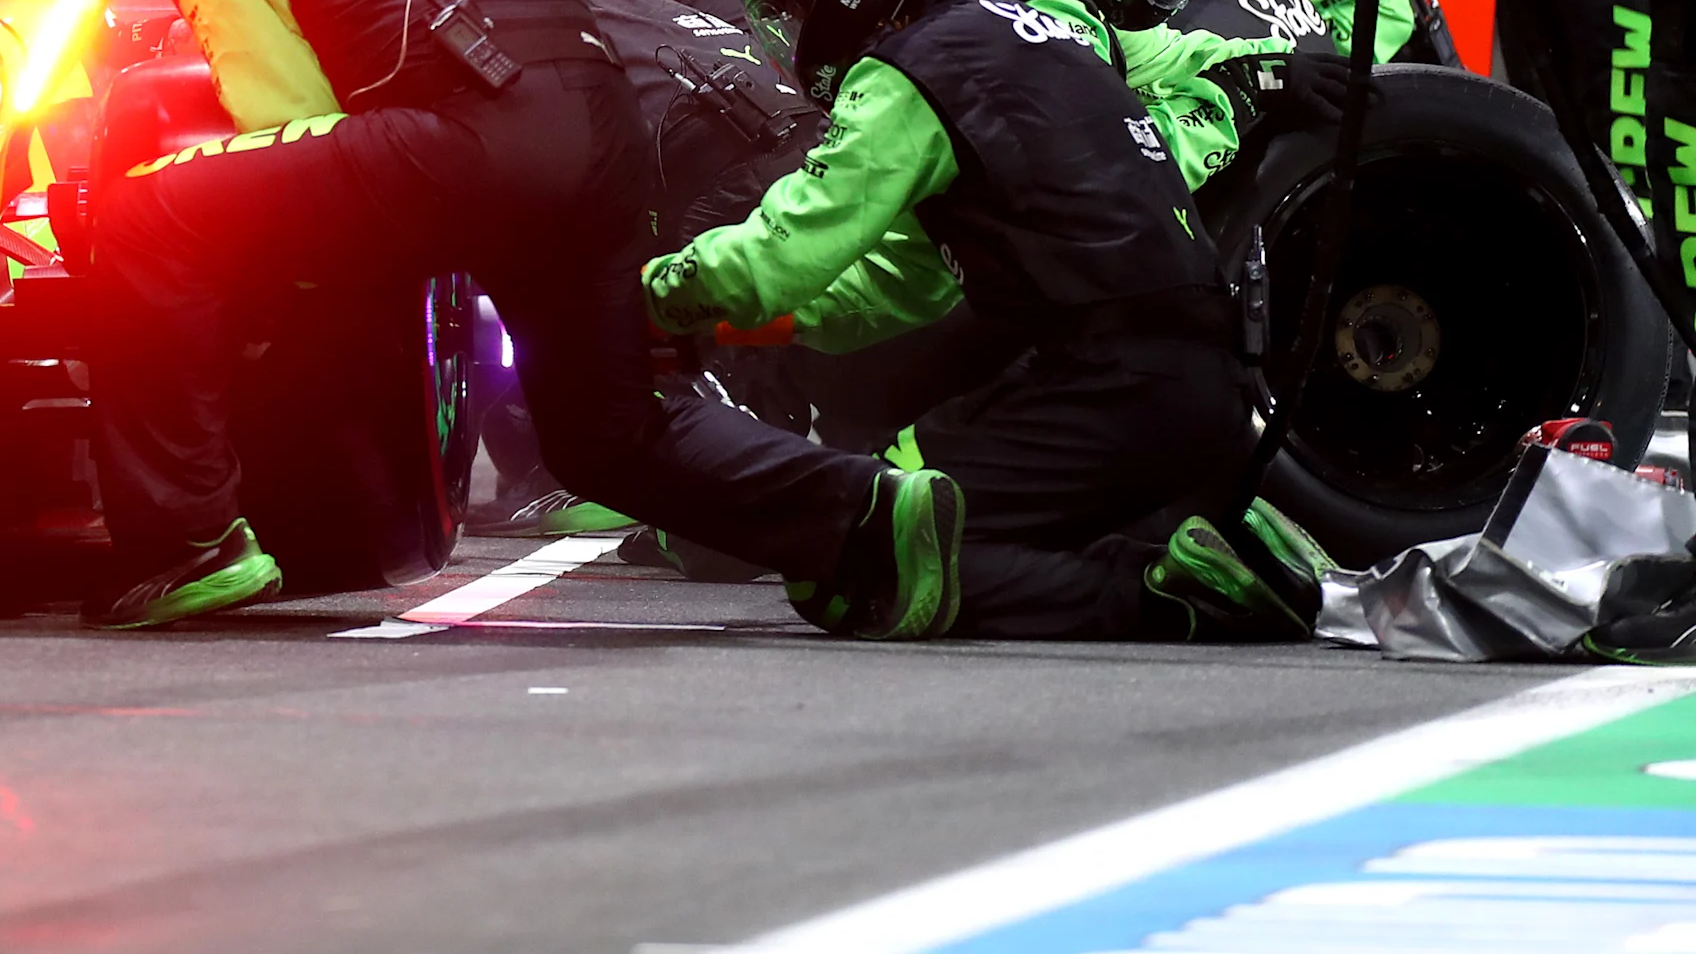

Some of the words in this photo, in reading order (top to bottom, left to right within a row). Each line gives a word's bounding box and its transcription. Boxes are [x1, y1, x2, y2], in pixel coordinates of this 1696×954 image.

[811, 64, 837, 102] Stake
[1610, 4, 1654, 219] REW
[1570, 443, 1608, 453] FUEL
